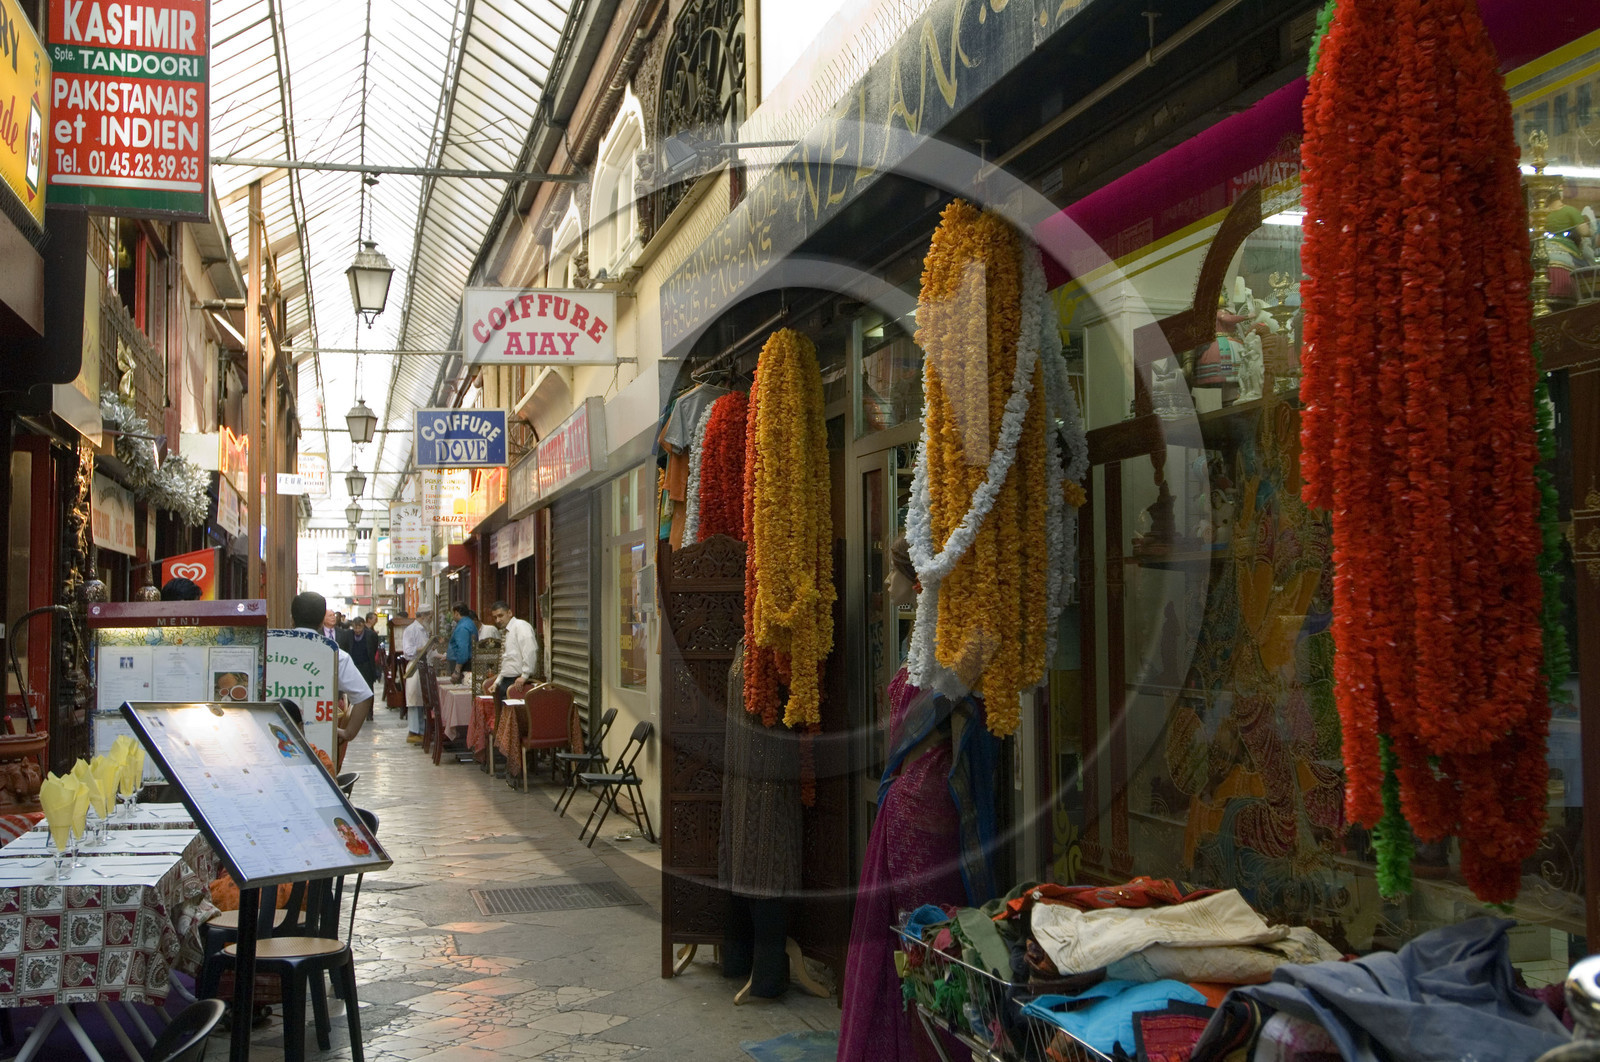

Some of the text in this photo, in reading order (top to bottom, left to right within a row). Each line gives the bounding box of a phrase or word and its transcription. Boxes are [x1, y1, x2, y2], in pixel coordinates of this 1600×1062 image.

[63, 0, 196, 51] KASHMIR
[79, 50, 198, 77] TANDOORI
[54, 78, 198, 118] PAKISTANAIS
[54, 114, 198, 151] et INDIEN
[55, 149, 199, 180] Tel. 01.45.23.39.35
[472, 294, 608, 344] COIFFURE
[503, 332, 580, 356] AJAY
[420, 414, 502, 442] COIFFURE
[437, 440, 487, 462] DOVE
[157, 617, 199, 626] MENU
[303, 661, 320, 676] du
